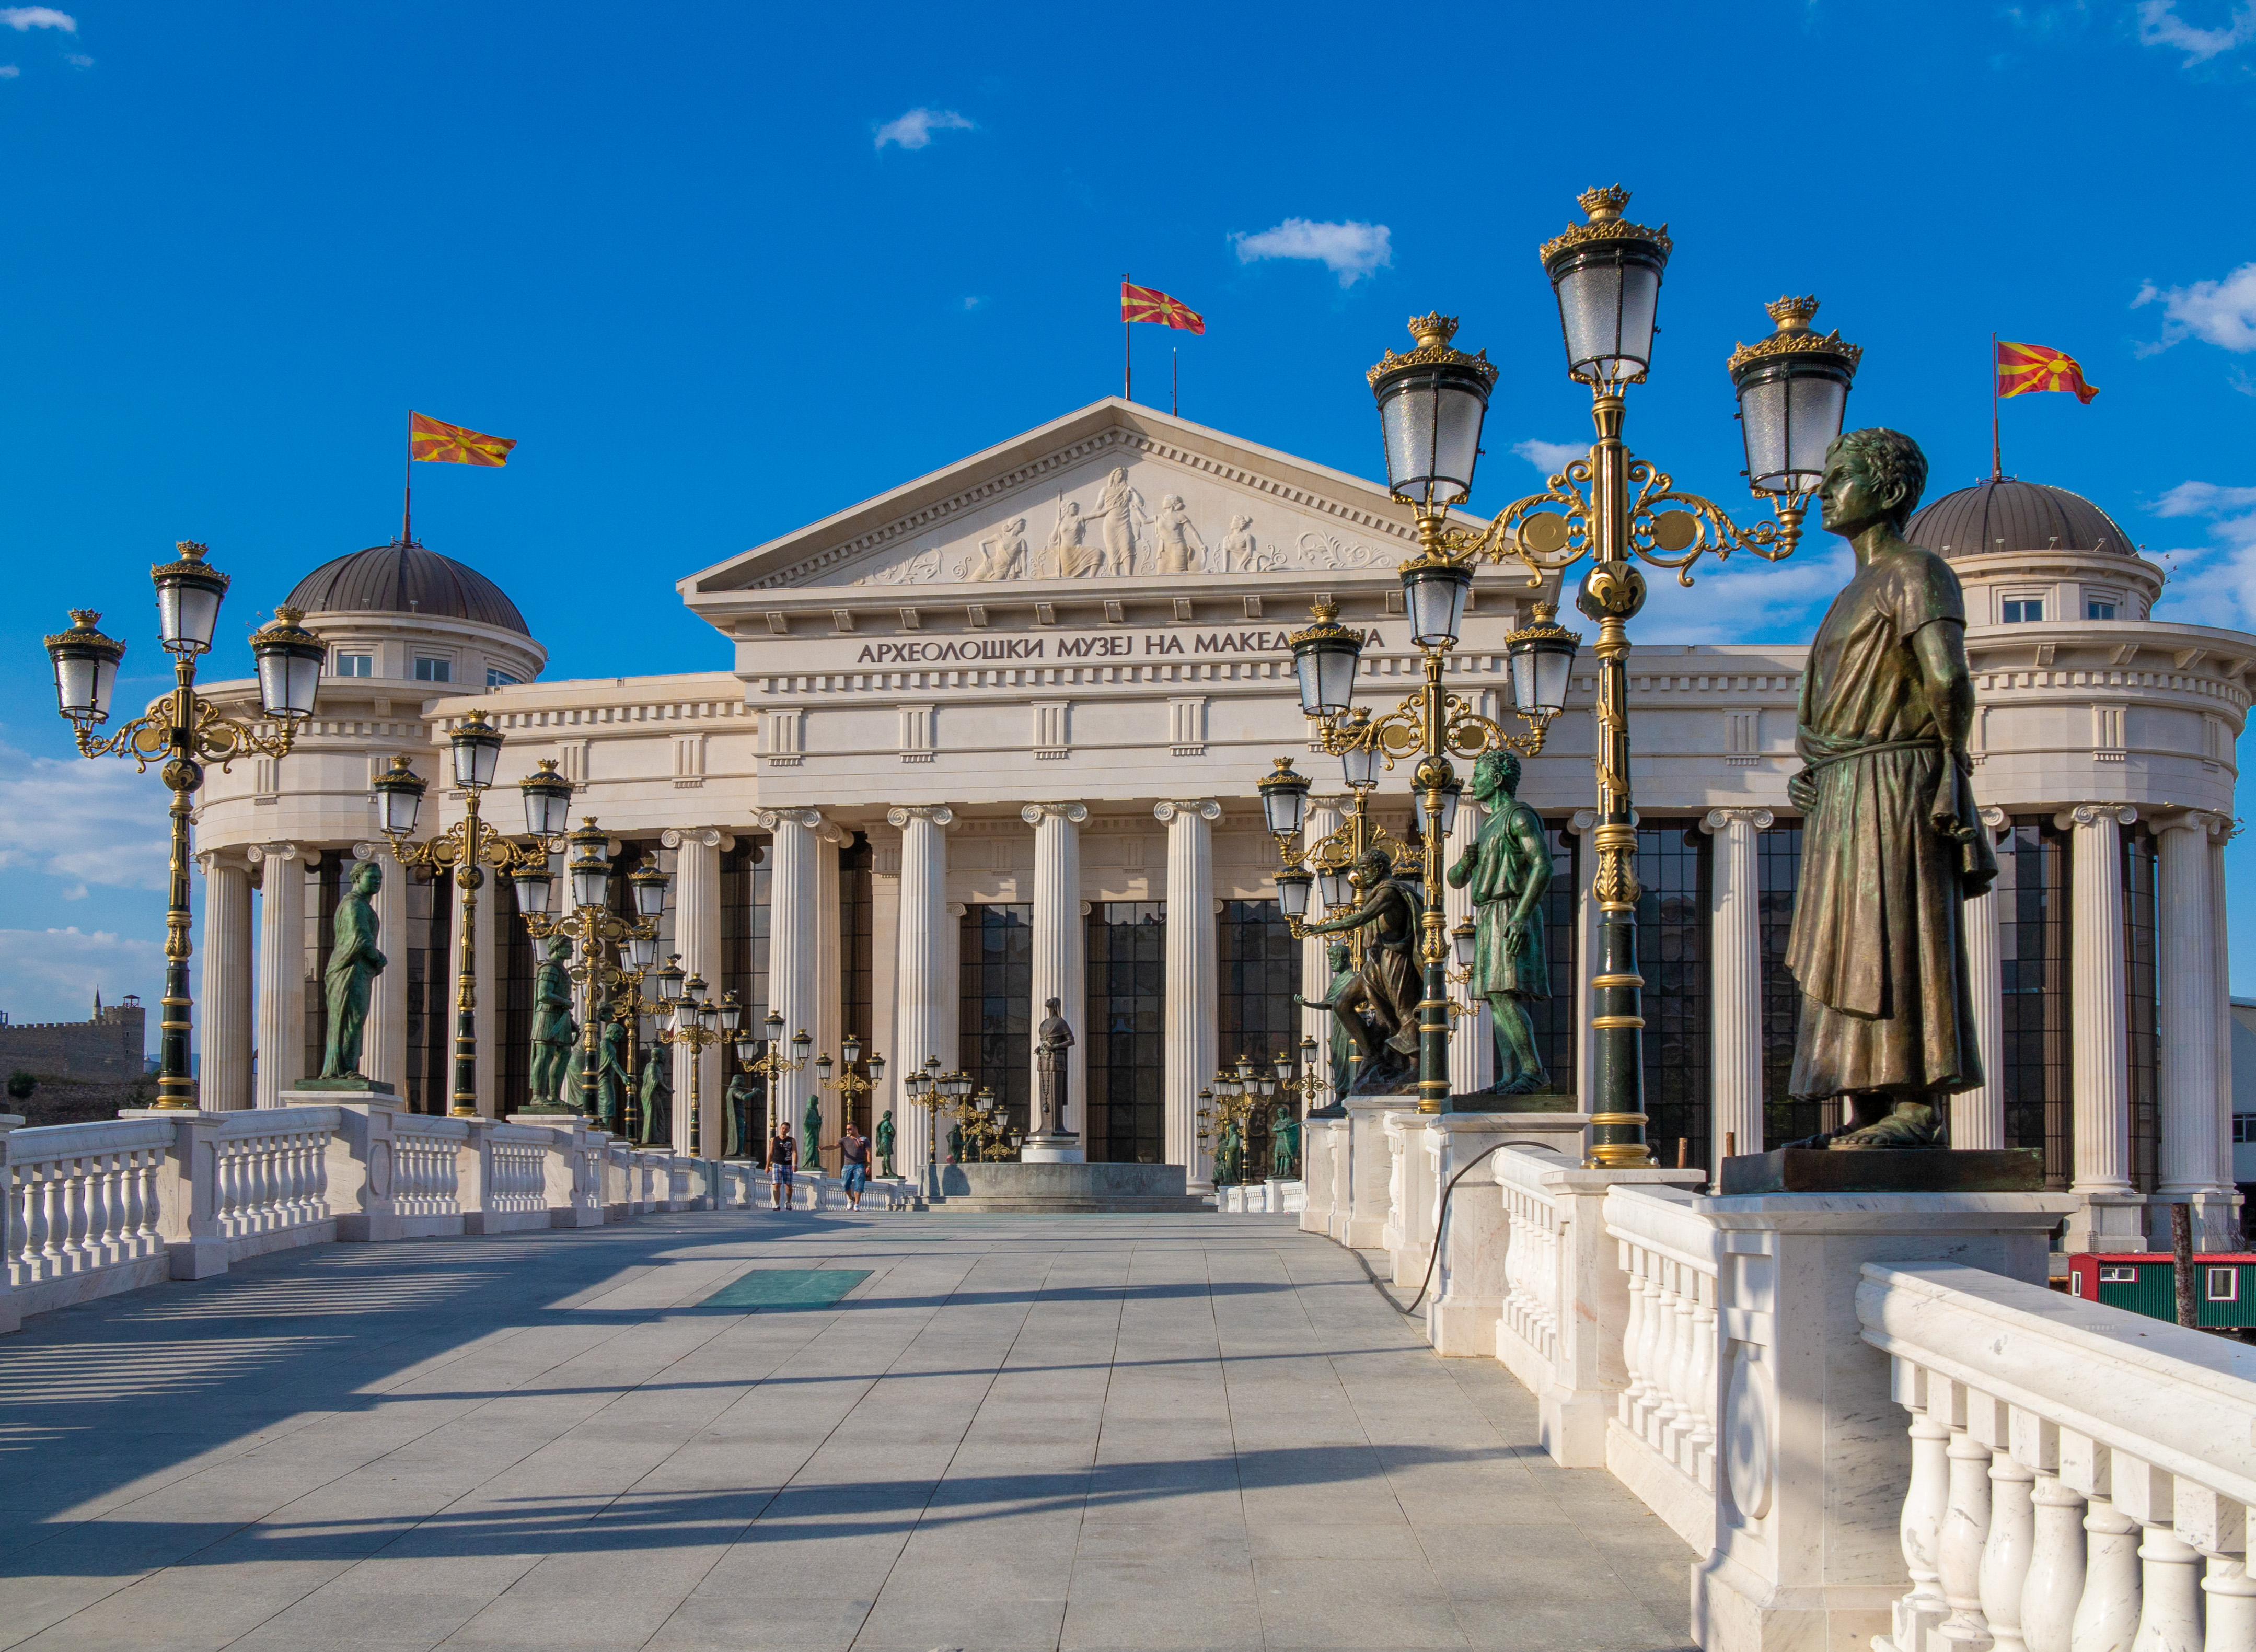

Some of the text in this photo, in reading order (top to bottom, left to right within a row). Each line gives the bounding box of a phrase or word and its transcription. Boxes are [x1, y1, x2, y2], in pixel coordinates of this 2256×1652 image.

[857, 628, 1385, 663] АРХЕОЛОШКИ МУЗЕЈ НА МАКЕДА
